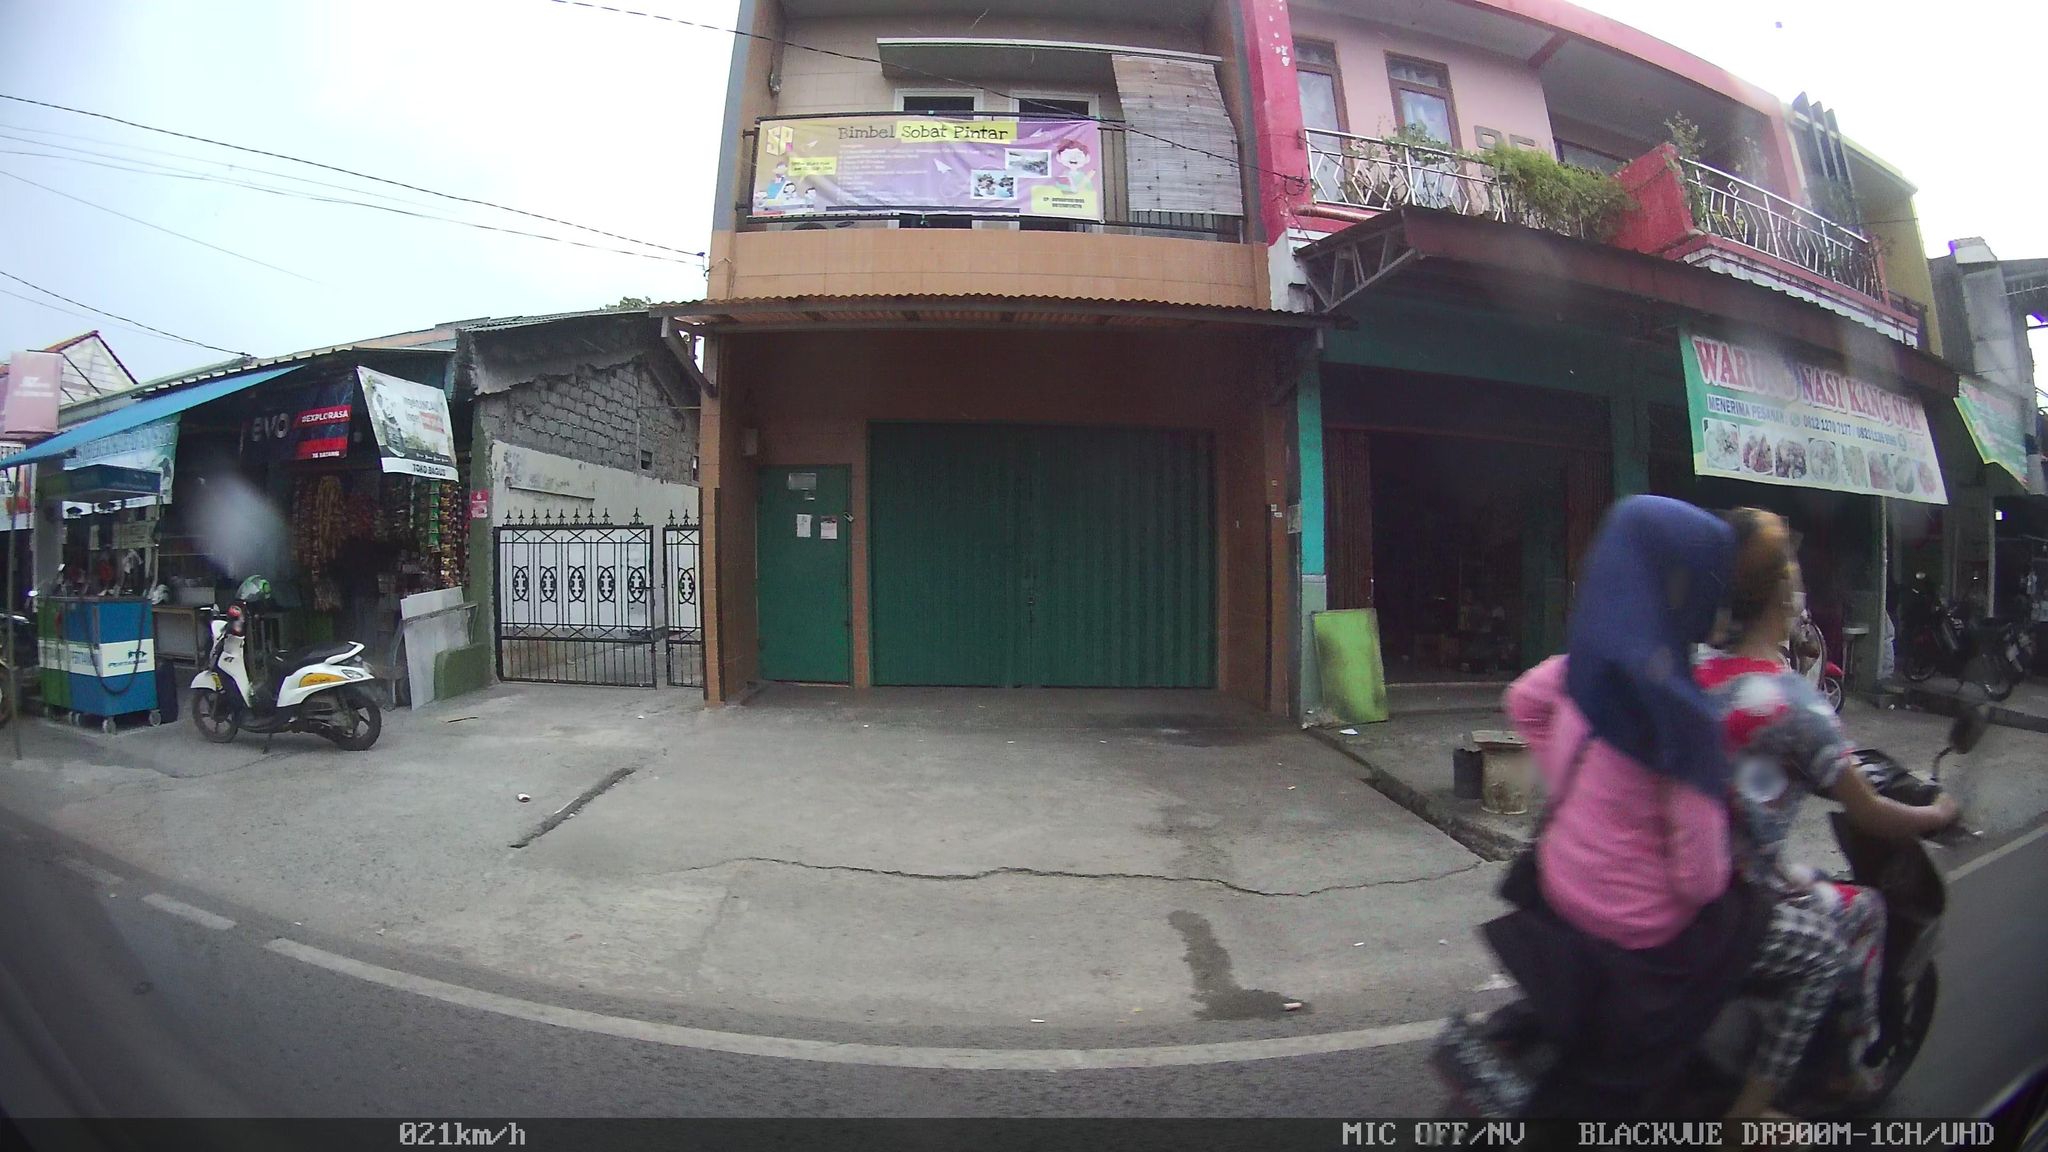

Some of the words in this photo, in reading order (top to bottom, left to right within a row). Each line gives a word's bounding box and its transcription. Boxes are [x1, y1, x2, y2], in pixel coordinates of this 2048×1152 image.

[837, 125, 896, 140] Bimbel
[901, 125, 948, 139] Sobat
[953, 126, 1009, 141] Pintar
[1693, 337, 1797, 400] WAR
[1799, 366, 1846, 409] NASI
[1708, 396, 1750, 419] MENERIMA
[411, 463, 428, 475] TOKO
